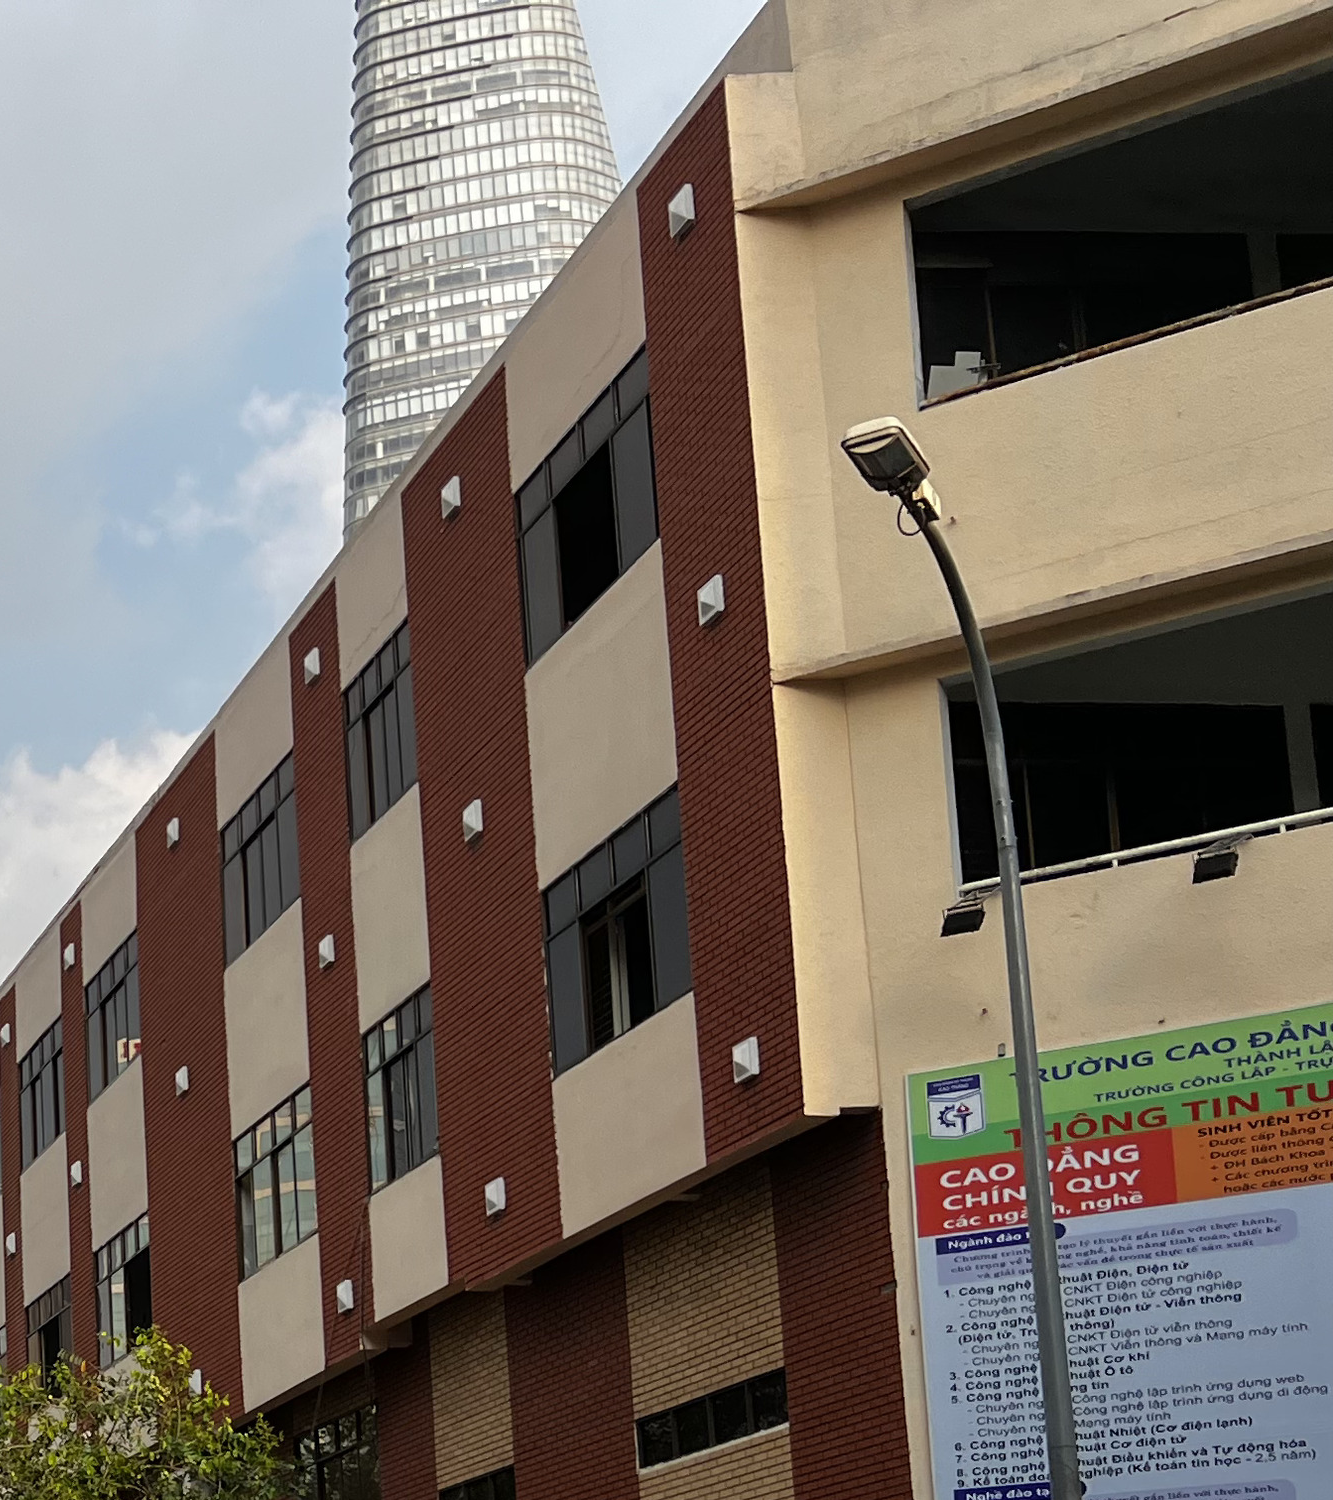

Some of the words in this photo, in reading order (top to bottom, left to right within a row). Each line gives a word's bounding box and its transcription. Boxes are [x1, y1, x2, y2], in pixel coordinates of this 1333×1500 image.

[1164, 1037, 1237, 1061] CAO
[1247, 1016, 1333, 1047] ĐẲN
[1222, 1047, 1305, 1067] THÀNH
[1092, 1082, 1174, 1101] TRƯỜNG
[1179, 1073, 1234, 1088] CÔNG
[1240, 1066, 1275, 1079] LẬP
[1181, 1092, 1260, 1122] TIN
[938, 1156, 1016, 1187] CAO
[1046, 1144, 1139, 1171] ẲNG
[1065, 1169, 1141, 1192] QUY
[942, 1214, 981, 1228] các
[988, 1202, 1071, 1224] ngàh,
[1080, 1191, 1144, 1214] nghề
[947, 1235, 992, 1251] Ngành
[995, 1231, 1022, 1244] đào
[958, 1286, 994, 1296] Công
[1062, 1282, 1103, 1298] CNKT
[1140, 1276, 1173, 1286] công
[1063, 1294, 1103, 1310] CNKT
[1159, 1286, 1191, 1296] công
[960, 1321, 997, 1331] Công
[1199, 1293, 1242, 1304] thông
[1066, 1331, 1106, 1345] CNKT
[1194, 1319, 1232, 1329] thông
[1067, 1343, 1107, 1358] CNKT
[1144, 1337, 1182, 1347] thông
[963, 1369, 1000, 1378] Công
[1274, 1374, 1305, 1383] web
[964, 1380, 1001, 1390] Công
[965, 1392, 1002, 1402] Công
[969, 1440, 1005, 1449] Công
[970, 1452, 1006, 1461] Công
[1005, 1486, 1032, 1500] đào
